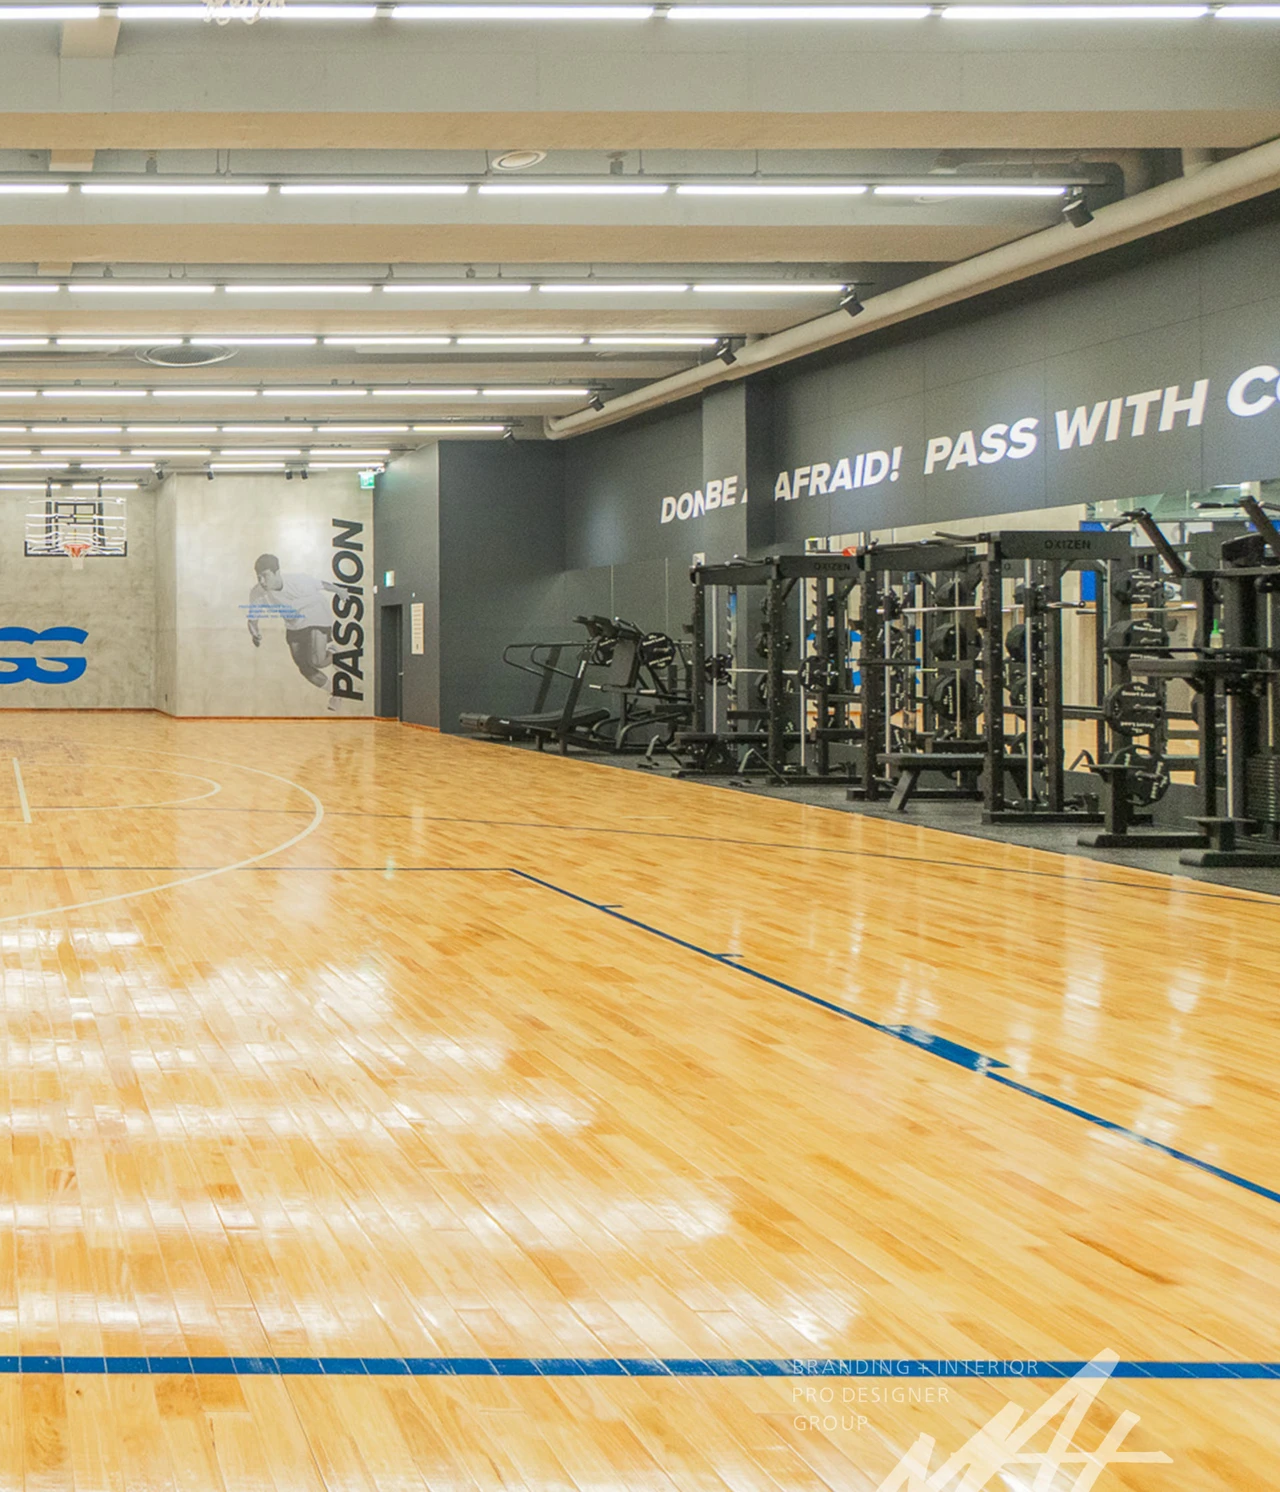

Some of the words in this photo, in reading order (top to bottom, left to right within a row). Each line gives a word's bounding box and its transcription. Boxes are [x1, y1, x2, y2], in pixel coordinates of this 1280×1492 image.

[705, 475, 738, 511] BE
[774, 446, 903, 502] AFRAID!
[924, 417, 1039, 475] PASS
[1055, 378, 1210, 451] WITH
[332, 518, 364, 701] PASSION
[1044, 540, 1092, 550] OXIZEN
